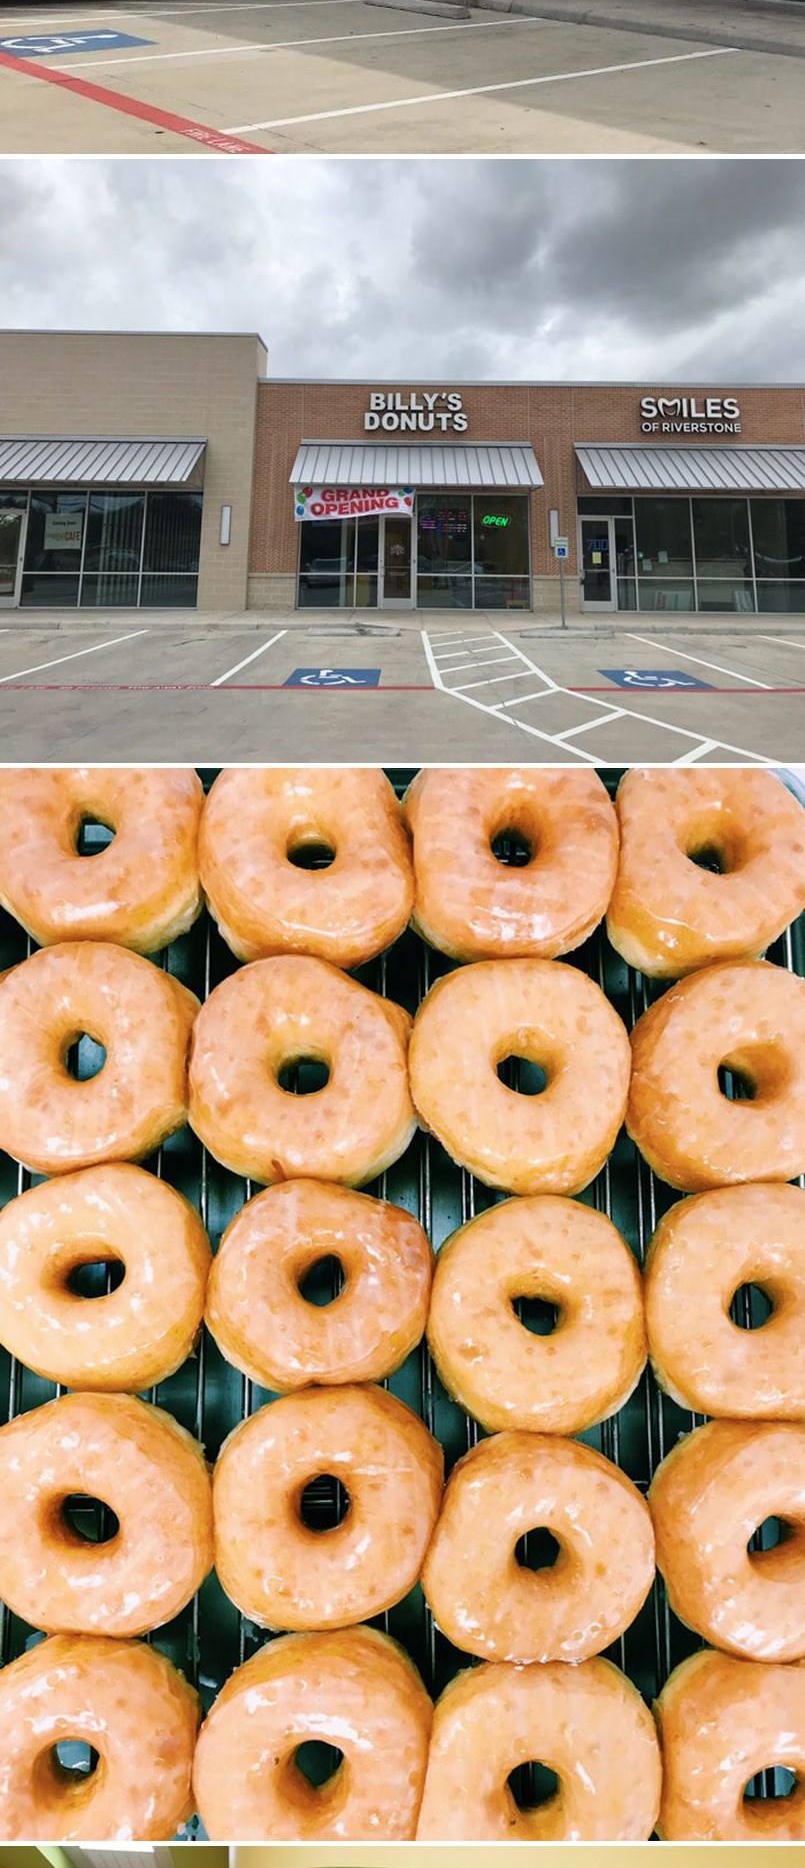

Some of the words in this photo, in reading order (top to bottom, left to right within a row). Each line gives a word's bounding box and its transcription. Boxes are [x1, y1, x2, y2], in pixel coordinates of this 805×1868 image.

[370, 392, 462, 411] BILLY'S
[641, 397, 740, 419] SMILES
[364, 412, 468, 431] DONUTS
[641, 421, 659, 433] OF
[662, 422, 742, 433] RIVERSTONE
[321, 489, 390, 502] GRAND
[310, 497, 399, 516] OPENING
[482, 514, 509, 527] OPEN
[585, 538, 609, 551] 700
